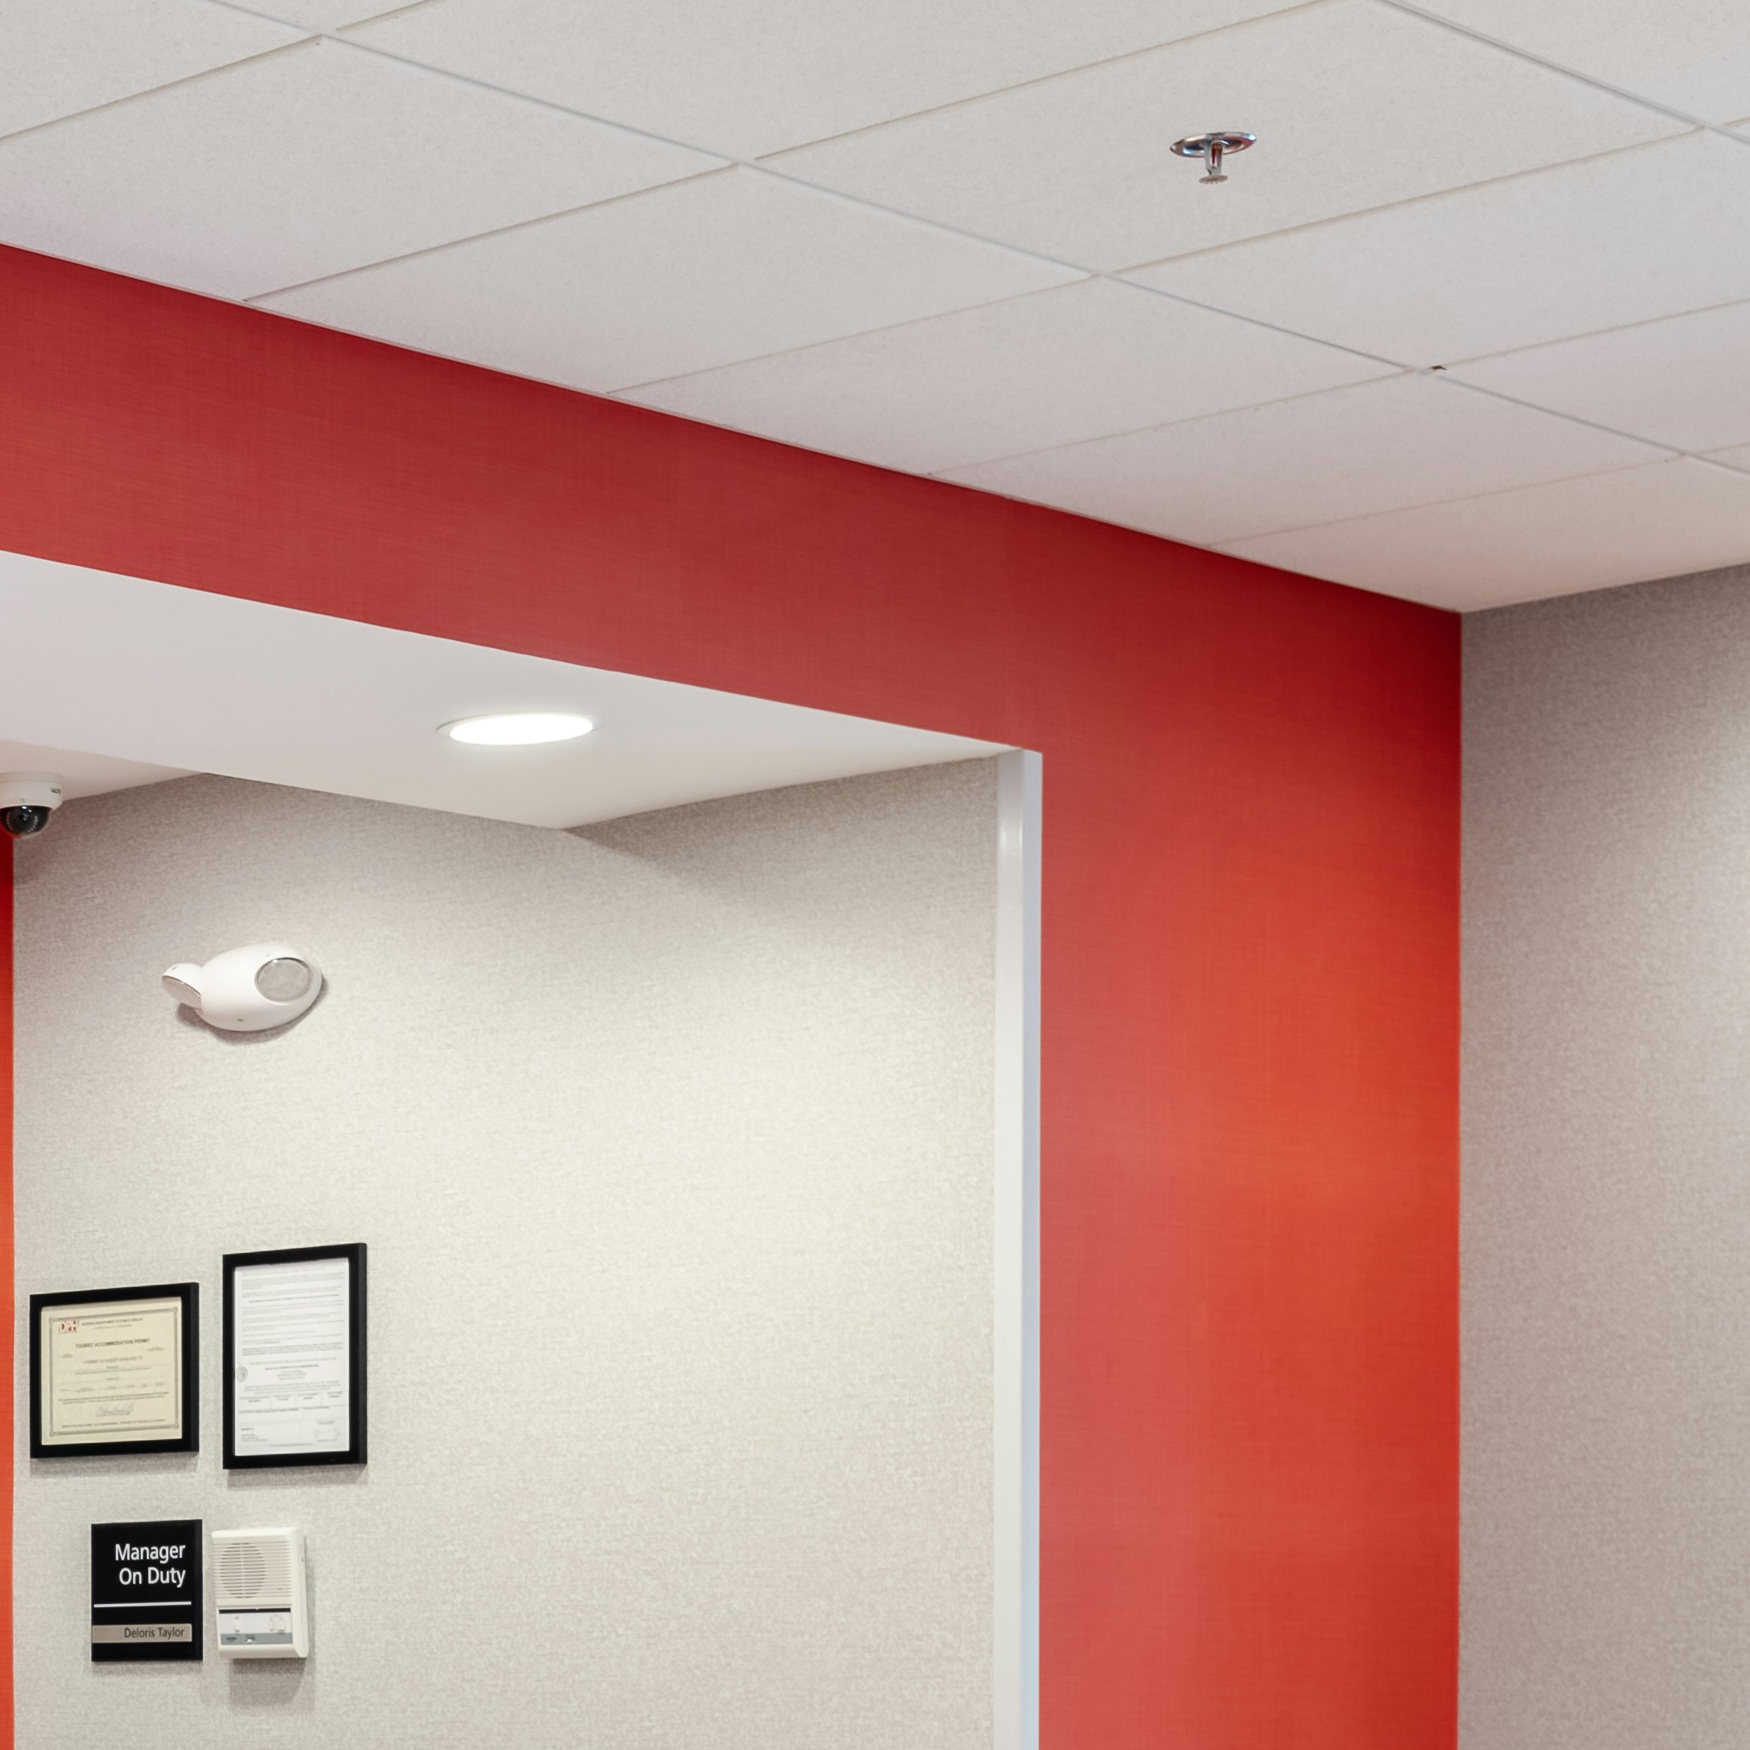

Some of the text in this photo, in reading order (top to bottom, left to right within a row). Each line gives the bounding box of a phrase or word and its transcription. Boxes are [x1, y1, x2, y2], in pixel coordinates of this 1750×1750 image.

[114, 1543, 186, 1564] Manager
[119, 1566, 186, 1588] On Duty
[124, 1627, 185, 1639] Deloris Taylor
